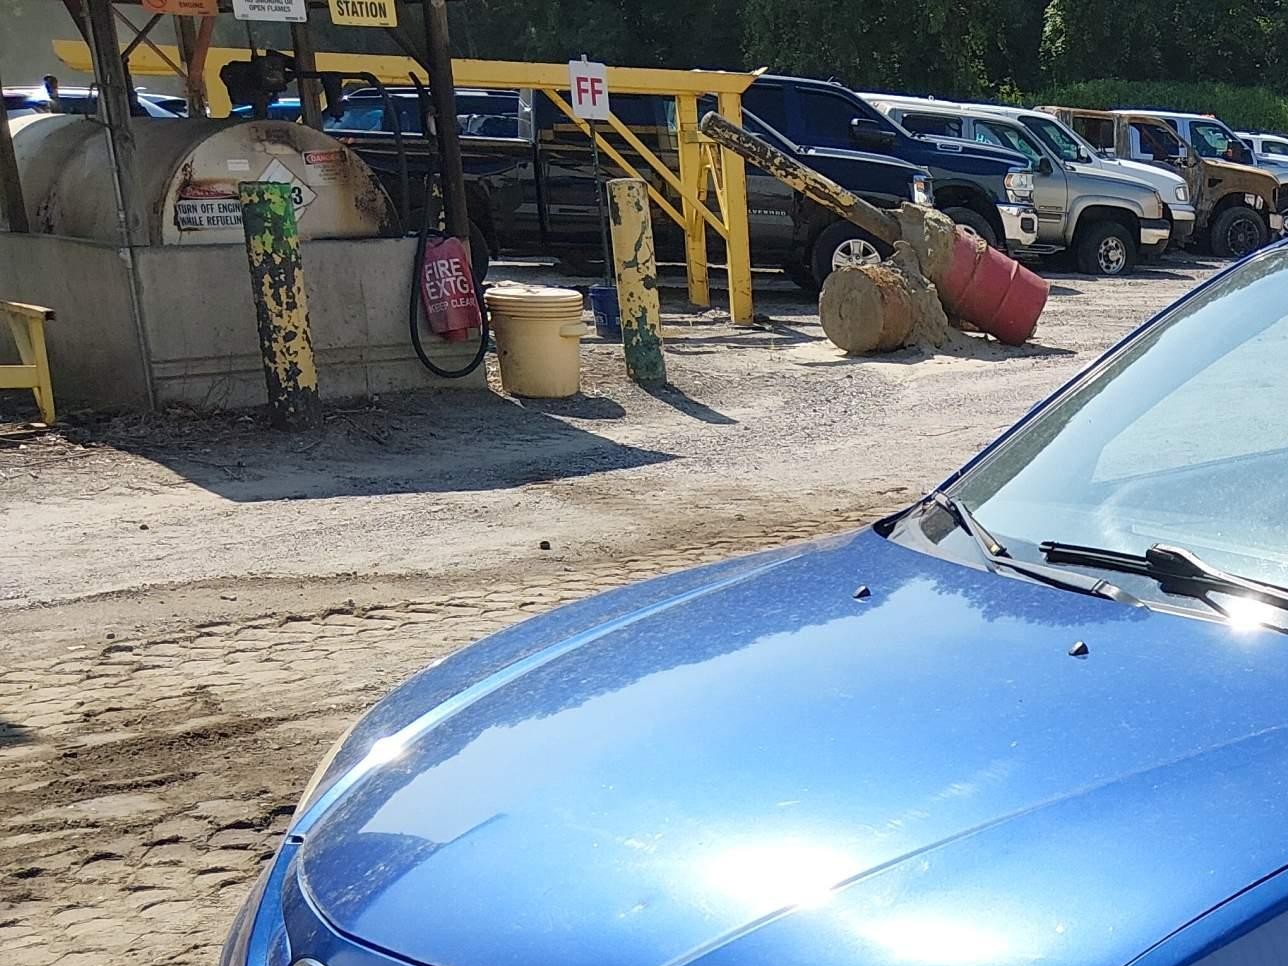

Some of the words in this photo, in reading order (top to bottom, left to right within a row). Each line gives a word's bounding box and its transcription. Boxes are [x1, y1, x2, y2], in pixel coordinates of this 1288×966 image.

[337, 0, 387, 18] STATION
[576, 76, 603, 106] FF
[178, 204, 197, 214] TURN
[201, 203, 214, 213] OFF
[218, 203, 241, 213] ENGIN
[180, 215, 204, 226] WHILE
[207, 215, 242, 226] REFUELIN
[424, 258, 463, 282] FIRE
[426, 276, 475, 300] EXTG.
[429, 301, 449, 314] KEEP
